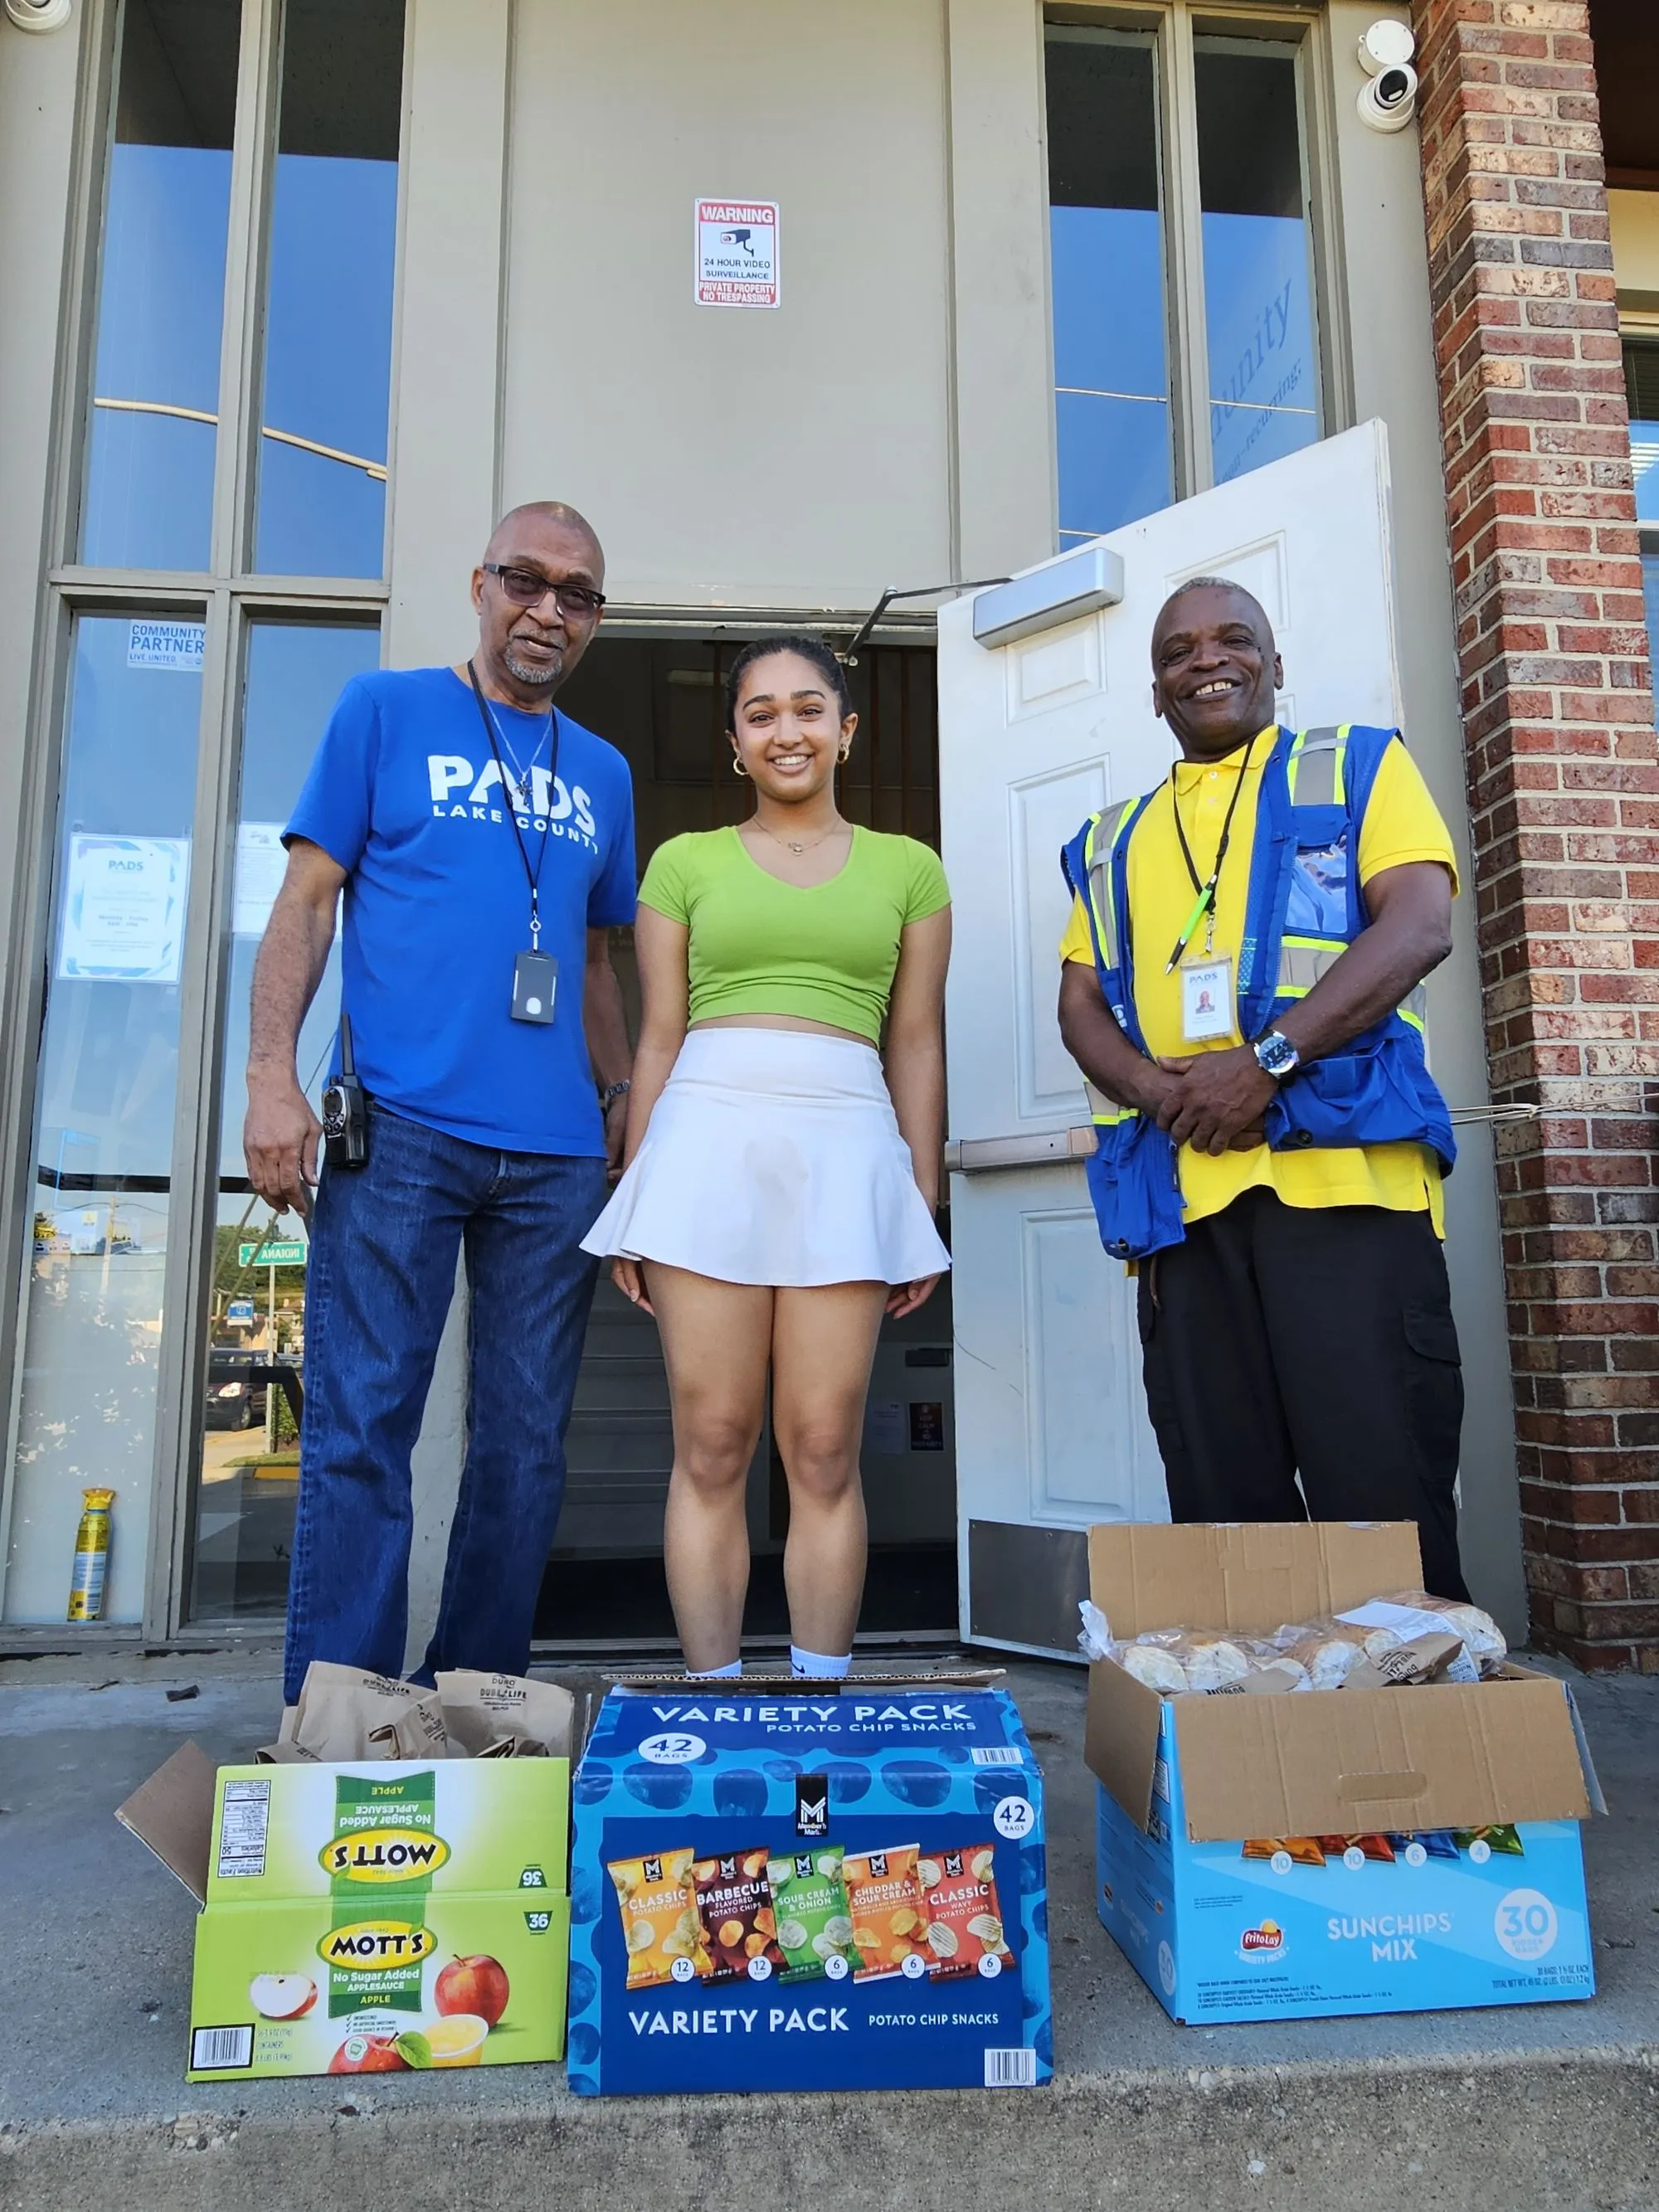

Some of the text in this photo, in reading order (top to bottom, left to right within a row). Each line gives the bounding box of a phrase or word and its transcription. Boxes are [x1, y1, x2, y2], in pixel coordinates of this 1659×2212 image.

[702, 206, 773, 224] WARNING
[717, 259, 742, 267] HOUR
[744, 260, 770, 269] VIDEO
[705, 270, 769, 280] SURVEILLANCE
[700, 281, 775, 294] PRIVATE PROPERTY
[703, 292, 771, 304] NO TRESPASSING
[133, 625, 206, 639] COMMUNITY
[131, 635, 205, 654] PARTNER
[428, 755, 596, 837] PADS
[433, 805, 503, 823] LAKE
[109, 859, 144, 871] PADS
[1190, 971, 1218, 982] PADS
[652, 1703, 972, 1722] VARIETY PACK
[766, 1722, 977, 1733] POTATO CHIP SNACKS
[649, 1738, 692, 1752] 42
[372, 1787, 404, 1795] APPLE
[355, 1805, 419, 1815] APPLESAUCE
[1000, 1805, 1025, 1823] 42
[340, 1815, 431, 1827] No Sugar Added
[1347, 1853, 1362, 1864] 10
[1412, 1850, 1420, 1861] 6
[1475, 1846, 1485, 1858] 4
[1274, 1858, 1289, 1869] 10
[523, 1871, 542, 1886] 36
[697, 1881, 769, 1906] BARBECUE
[778, 1887, 839, 1906] SOUR CREAM
[854, 1883, 902, 1898] CHEDDAR
[929, 1884, 989, 1905] CLASSIC
[629, 1889, 687, 1909] CLASSIC
[715, 1896, 753, 1909] FLAVORED
[798, 1897, 831, 1909] ONION
[853, 1889, 916, 1906] SOUR CREAM
[633, 1901, 687, 1916] POTATO CHIPS
[708, 1902, 761, 1918] POTATO CHIPS
[936, 1904, 989, 1919] POTATO CHIPS
[951, 1901, 972, 1909] WAVY
[529, 1913, 549, 1928] 36
[1327, 1913, 1451, 1941] SUNCHIPS
[1503, 1904, 1549, 1937] 30
[1372, 1939, 1418, 1962] MIX
[677, 1962, 688, 1972] 12
[753, 1961, 766, 1971] 12
[833, 1959, 839, 1969] 6
[910, 1957, 917, 1968] 6
[987, 1957, 994, 1967] 6
[333, 1969, 420, 1982] No Sugar Added
[347, 1981, 405, 1992] APPLESAUCE
[360, 1995, 392, 2004] APPLE
[629, 2008, 999, 2035] VARIETY PACK POTATO CHIP SNACKS
